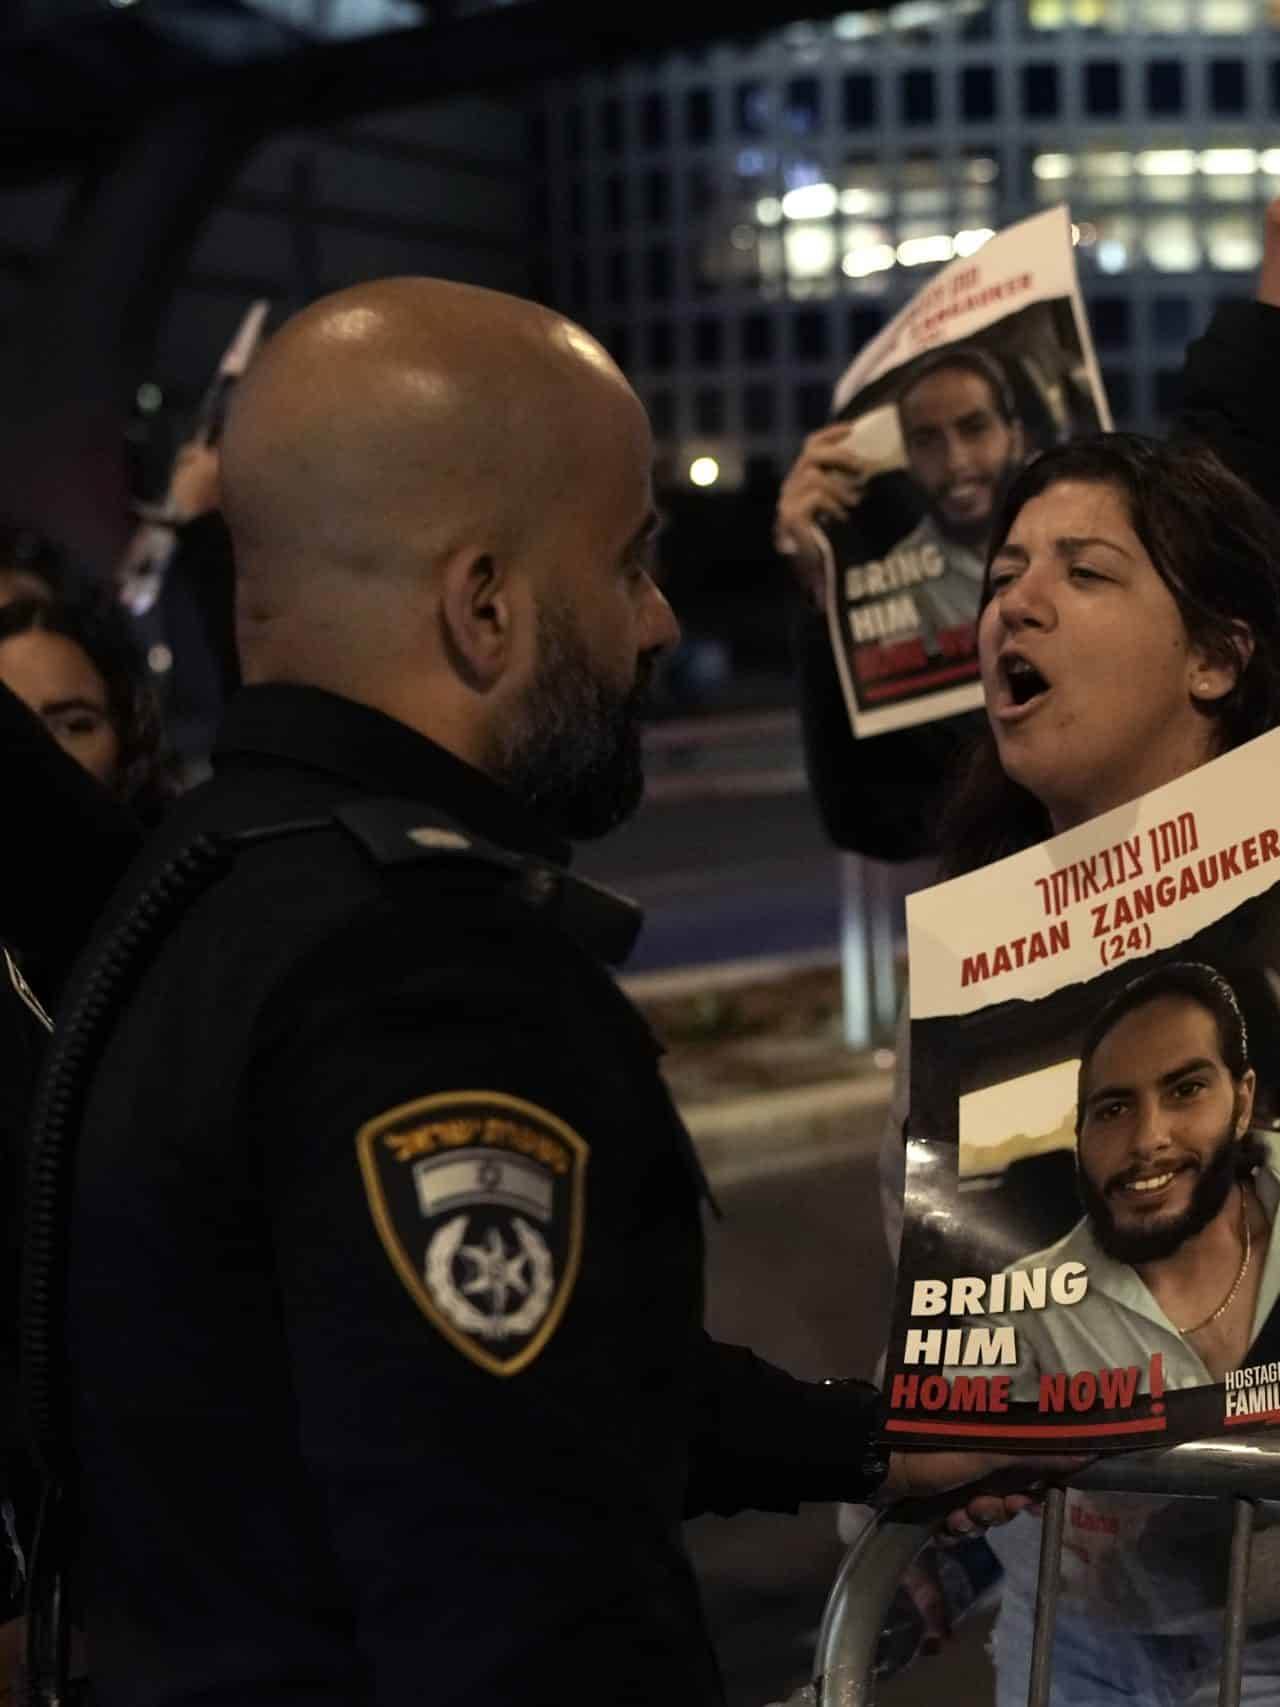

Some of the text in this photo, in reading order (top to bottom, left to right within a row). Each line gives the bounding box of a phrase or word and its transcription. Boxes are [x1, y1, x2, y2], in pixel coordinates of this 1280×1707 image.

[846, 544, 945, 601] BRING
[850, 594, 919, 643] HIM
[1035, 811, 1199, 916] מתן צנגאוקר
[961, 921, 1071, 988] MATAN
[1100, 922, 1152, 966] (24)
[910, 1260, 1089, 1317] BRING
[903, 1326, 1017, 1366] HIM
[890, 1373, 1009, 1412] HOME
